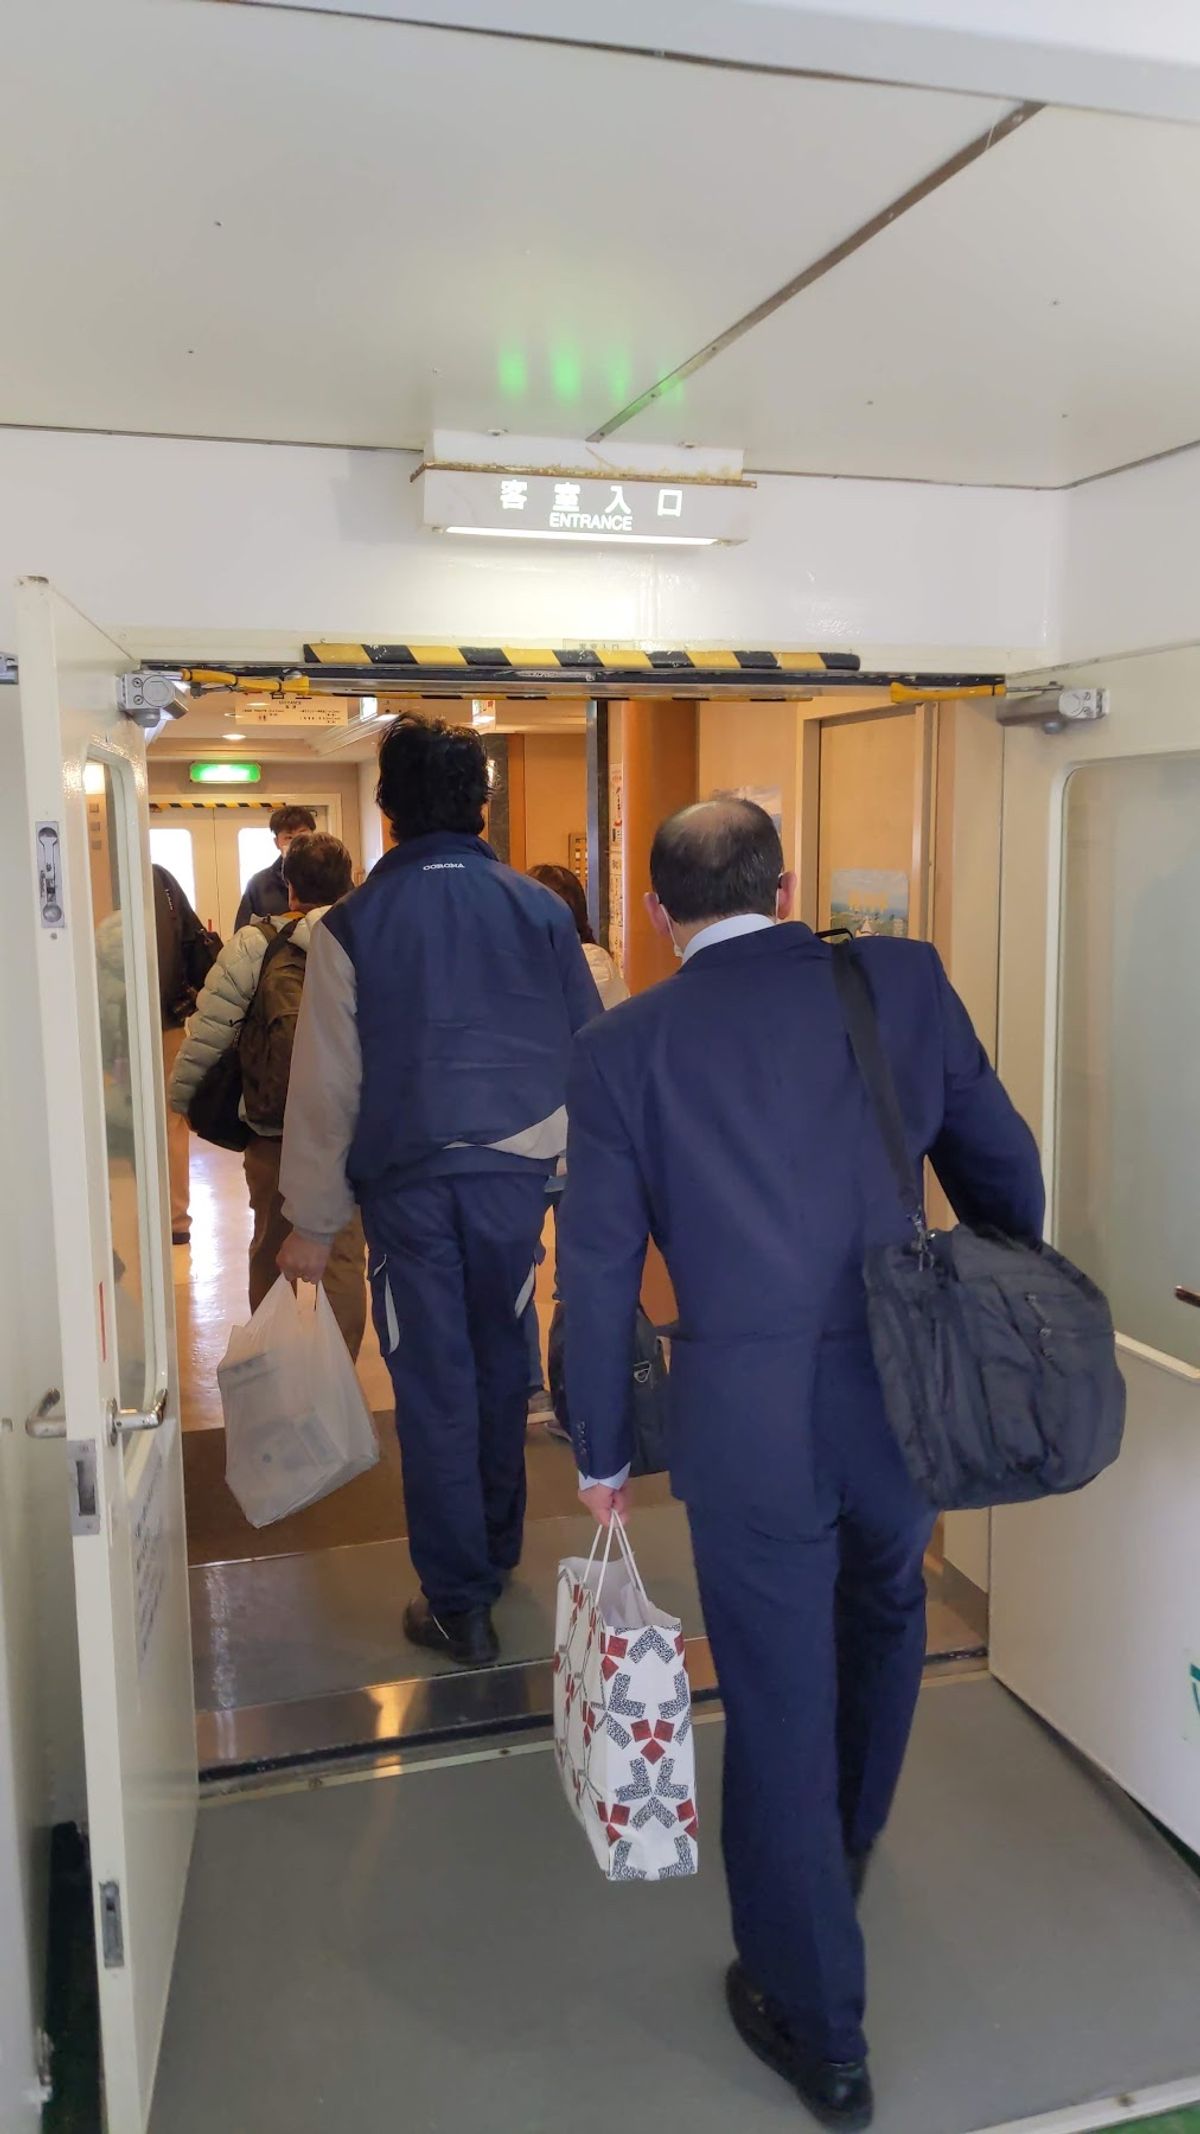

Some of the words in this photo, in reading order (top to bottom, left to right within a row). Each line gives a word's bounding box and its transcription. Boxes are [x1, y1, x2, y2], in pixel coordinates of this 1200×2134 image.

[500, 479, 683, 517] 客室入口
[549, 512, 633, 531] ENTRANCE
